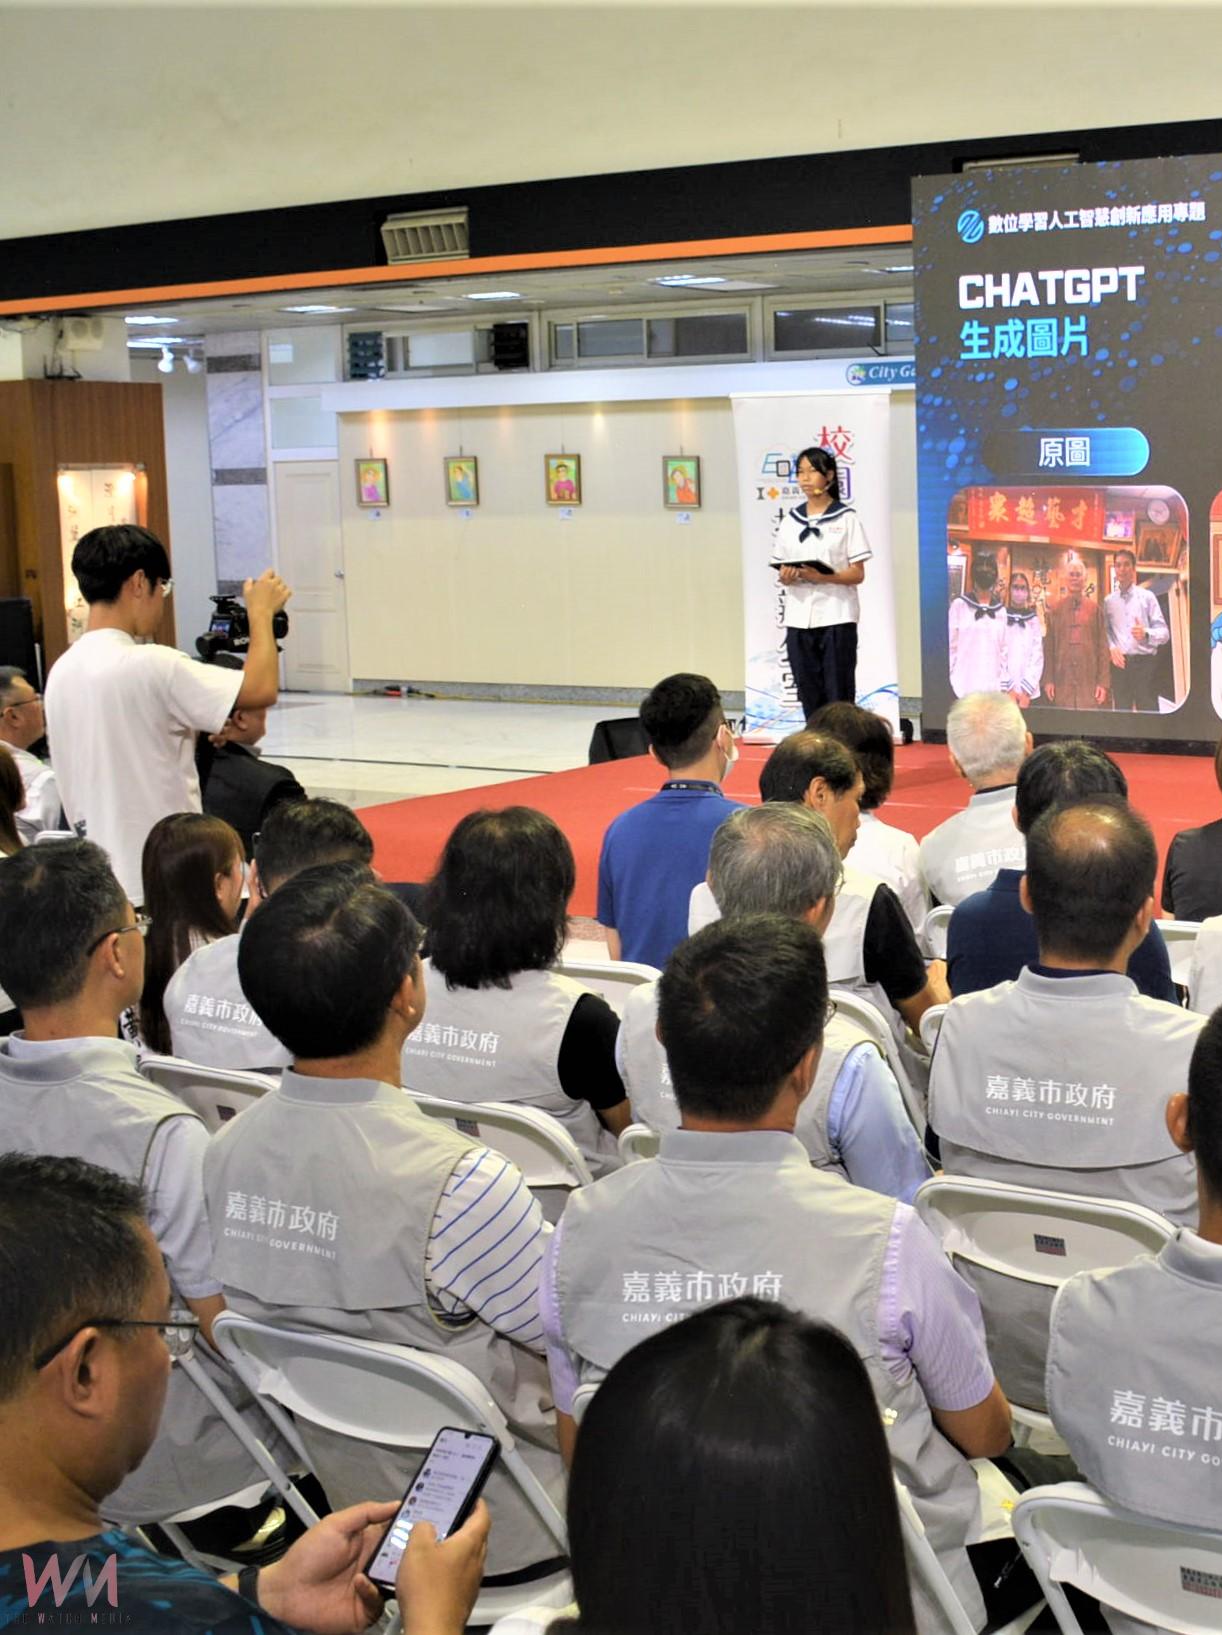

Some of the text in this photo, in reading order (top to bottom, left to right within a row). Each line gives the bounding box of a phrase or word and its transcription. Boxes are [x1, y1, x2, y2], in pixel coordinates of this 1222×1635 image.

[988, 201, 1206, 235] 數位學習人工智慧創新應用專題
[958, 265, 1145, 309] CHATGPT
[960, 316, 1089, 361] 生成圖片
[868, 365, 898, 382] City
[1038, 437, 1090, 467] 原圖
[985, 1075, 1117, 1110] 嘉義市政府
[985, 1106, 1115, 1126] CHIAYI CITY GOVERNMENT
[225, 1191, 340, 1241] 嘉義市政府
[622, 1270, 783, 1302] 嘉義市政府
[622, 1312, 689, 1323] CHIAYI CIT
[1107, 1435, 1156, 1454] CHIAYI
[1161, 1446, 1196, 1461] CITY
